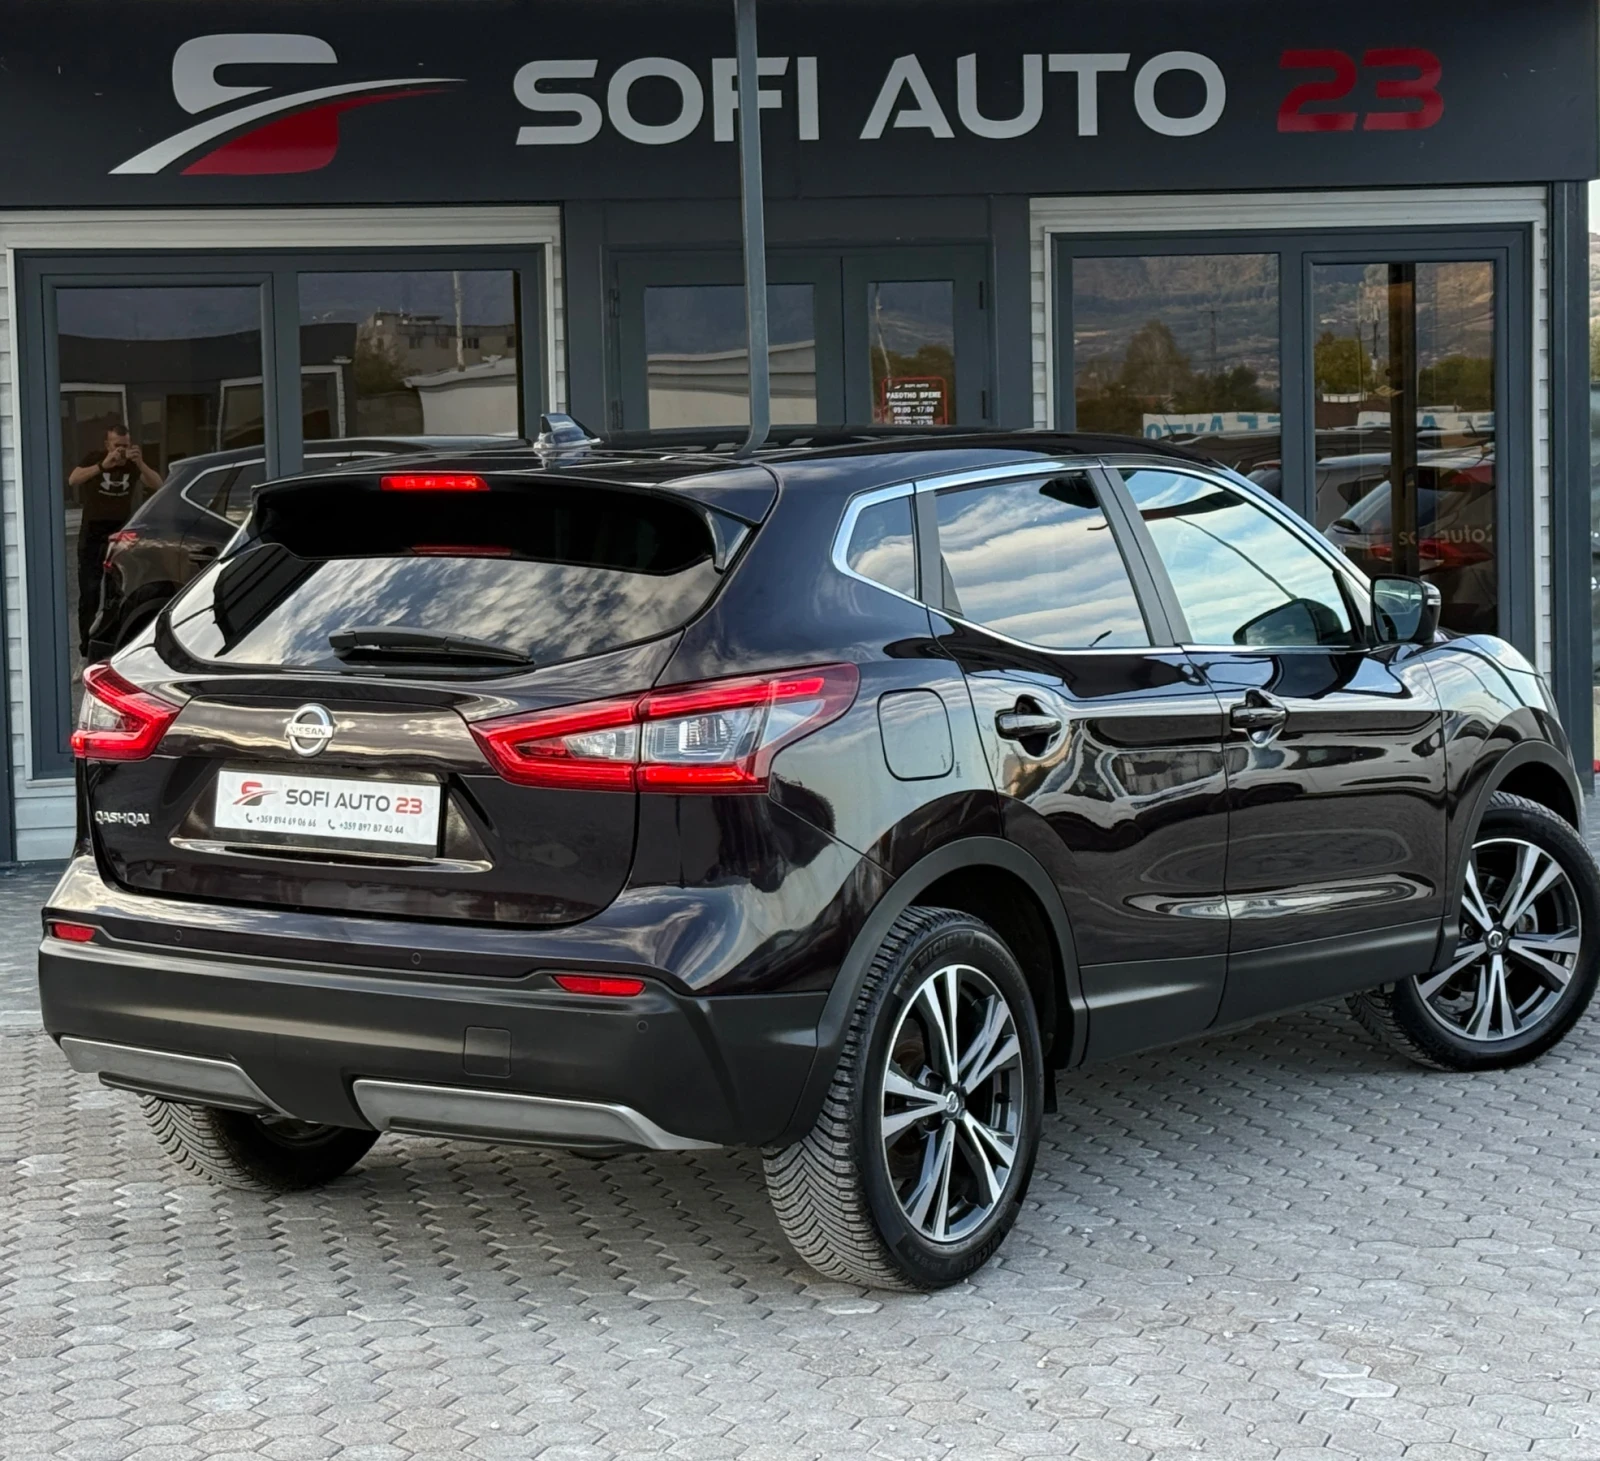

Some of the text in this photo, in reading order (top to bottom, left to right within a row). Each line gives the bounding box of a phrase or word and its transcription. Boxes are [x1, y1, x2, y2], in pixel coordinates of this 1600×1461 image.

[513, 47, 1446, 146] SOFI AUTO 23
[290, 726, 326, 736] NISSAN
[285, 789, 423, 815] SOFI AUTO 23
[95, 810, 151, 827] QASHQAI
[339, 821, 357, 831] +359
